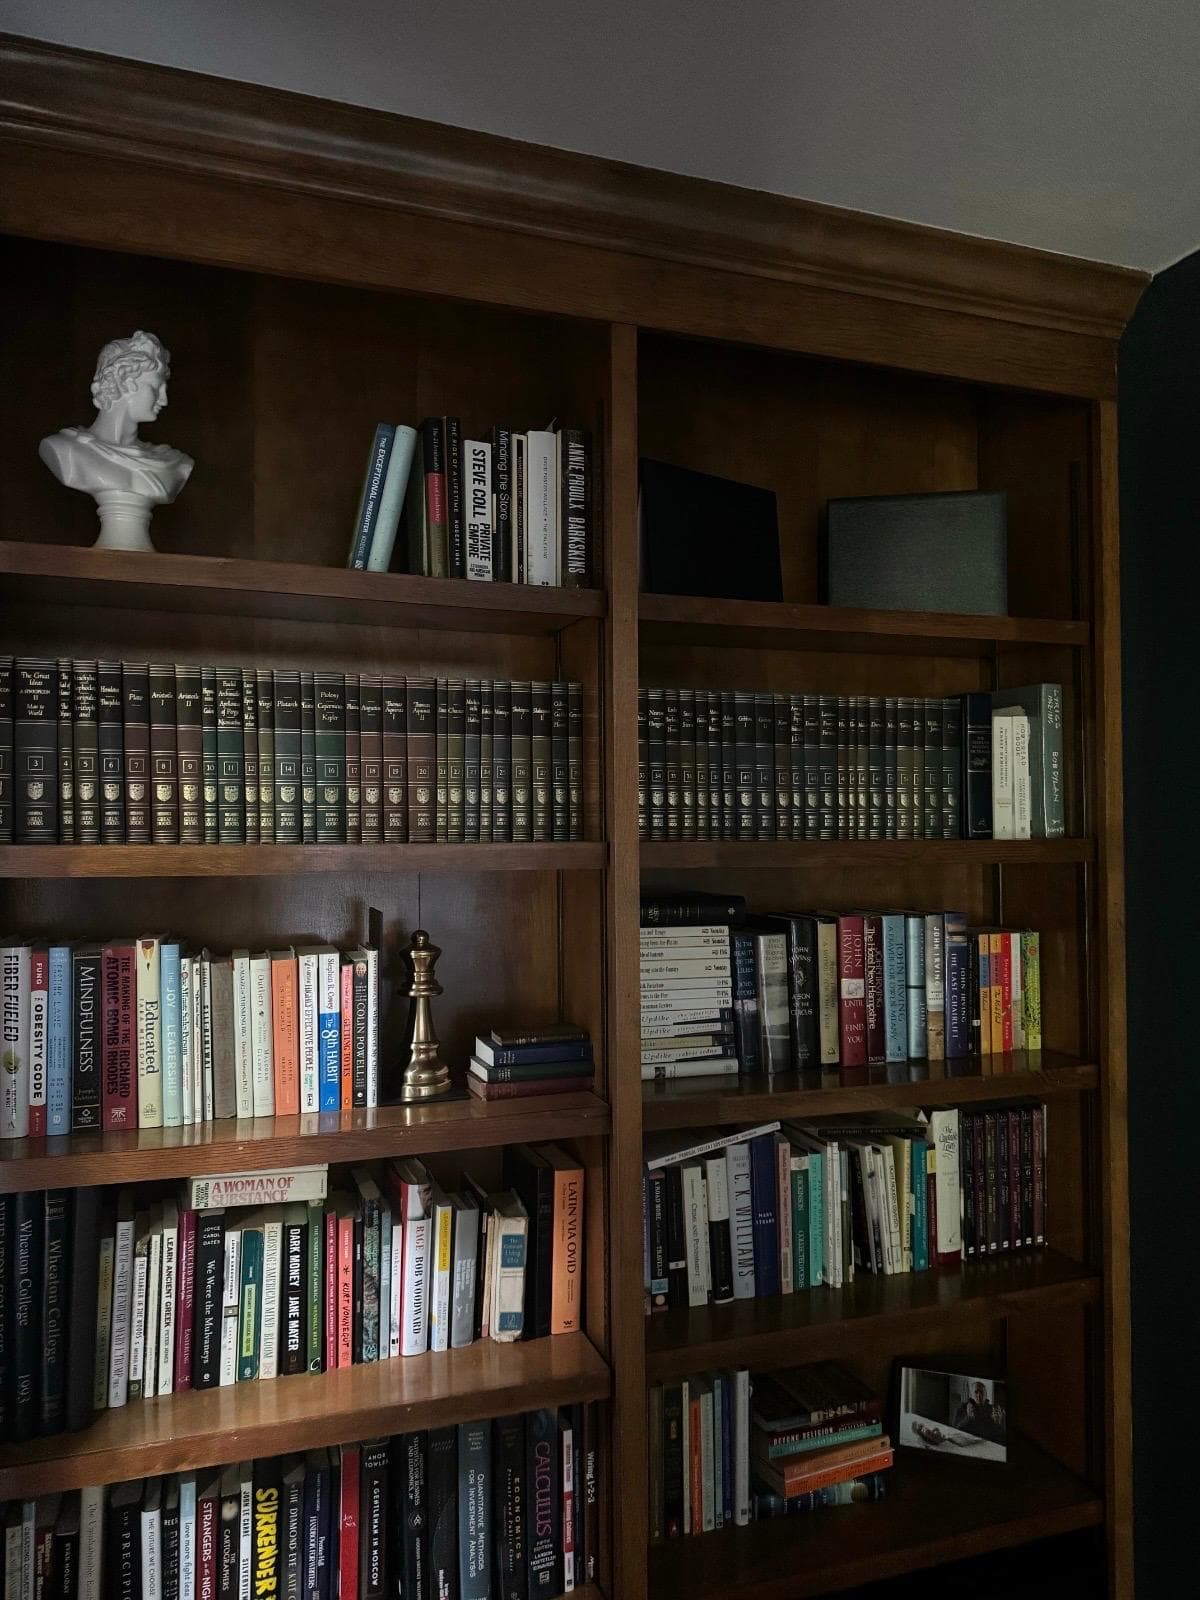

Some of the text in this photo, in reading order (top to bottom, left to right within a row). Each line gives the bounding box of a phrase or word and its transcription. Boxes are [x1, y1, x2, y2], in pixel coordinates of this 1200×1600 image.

[368, 448, 386, 500] EXCEPTIONAL
[452, 458, 458, 468] OF
[472, 448, 487, 519] STEVE COLL
[497, 430, 509, 521] Minding the Store
[567, 441, 586, 574] ANNIE PROULX BARKSKINS
[468, 523, 479, 558] EMPIRE
[479, 522, 491, 561] PRIVATE
[20, 672, 50, 680] The Great
[33, 760, 39, 768] 3
[63, 760, 69, 768] 4
[1051, 751, 1060, 802] BOB DYLAN
[842, 929, 853, 974] IRVING
[853, 934, 862, 967] JOHN
[933, 927, 941, 949] JOHN
[326, 958, 335, 983] Stephen
[867, 928, 877, 1030] The Hotel New Hampshire
[896, 944, 905, 1022] JOHN IRVING
[3, 955, 18, 1042] FIBER FUELED
[106, 957, 119, 1045] ATOMIC BOMB
[121, 956, 131, 1044] THE MAKING OF THE
[165, 987, 175, 1007] JOY
[326, 991, 335, 1009] Covey
[951, 995, 959, 1039] CHAIRLIFT
[33, 962, 43, 1099] FUNG OBESITY CODE
[79, 966, 97, 1073] MINDFULNESS
[144, 1000, 159, 1075] Educated
[304, 1009, 314, 1045] EFFECTIVE
[321, 1029, 339, 1047] 8th
[355, 1002, 365, 1077] COLIN POWELL
[166, 1024, 177, 1097] LEADERSHIP
[305, 1046, 314, 1071] PEOPLE
[327, 1051, 338, 1083] HABIT
[343, 1018, 351, 1077] GETTING TO YES
[107, 1050, 118, 1094] RHODES
[119, 1049, 130, 1097] RICHARD
[212, 1176, 295, 1194] A WOMAN OF
[566, 1181, 578, 1274] LATIN VIA OVID
[734, 1173, 754, 1277] C. K. WILLIAMS
[18, 1219, 33, 1276] Wheaton
[166, 1237, 174, 1263] LEARN
[44, 1239, 61, 1364] Wheaton College
[165, 1266, 173, 1298] ANCIENT
[265, 1267, 276, 1304] AMERICAN
[288, 1228, 301, 1351] DARK MONEY JANE MAYER
[412, 1225, 425, 1334] RAGE BOB WOODWARD
[16, 1279, 33, 1328] College
[164, 1302, 173, 1328] GREEK
[200, 1260, 216, 1364] We Were the Mulvaneys
[264, 1306, 275, 1328] MIND
[342, 1282, 350, 1348] KURT VONNEGUT
[263, 1333, 274, 1358] BLOOM
[289, 1488, 299, 1504] THE
[534, 1440, 552, 1537] CALCULUS
[586, 1451, 595, 1504] Wiring 1-2-3
[184, 1522, 192, 1538] love
[202, 1502, 212, 1562] STRANGERS
[243, 1508, 250, 1516] LE
[289, 1508, 298, 1549] DIAMOND
[372, 1487, 380, 1535] GENTLEMAN
[468, 1487, 476, 1536] INVESTMENT
[477, 1473, 485, 1571] QUANTITATIVE METHODS
[513, 1477, 522, 1560] ECONOMICS
[36, 1544, 45, 1577] Flower
[149, 1557, 155, 1566] WE
[222, 1528, 231, 1592] CARTOGRAPHERS
[255, 1487, 279, 1596] SURRENDER
[288, 1553, 298, 1568] EYE
[372, 1537, 379, 1547] IN
[468, 1540, 477, 1578] ANALYSIS
[148, 1568, 156, 1596] CHOOSE
[182, 1562, 192, 1581] fight
[184, 1582, 192, 1597] less
[371, 1550, 379, 1586] MOSCOW
